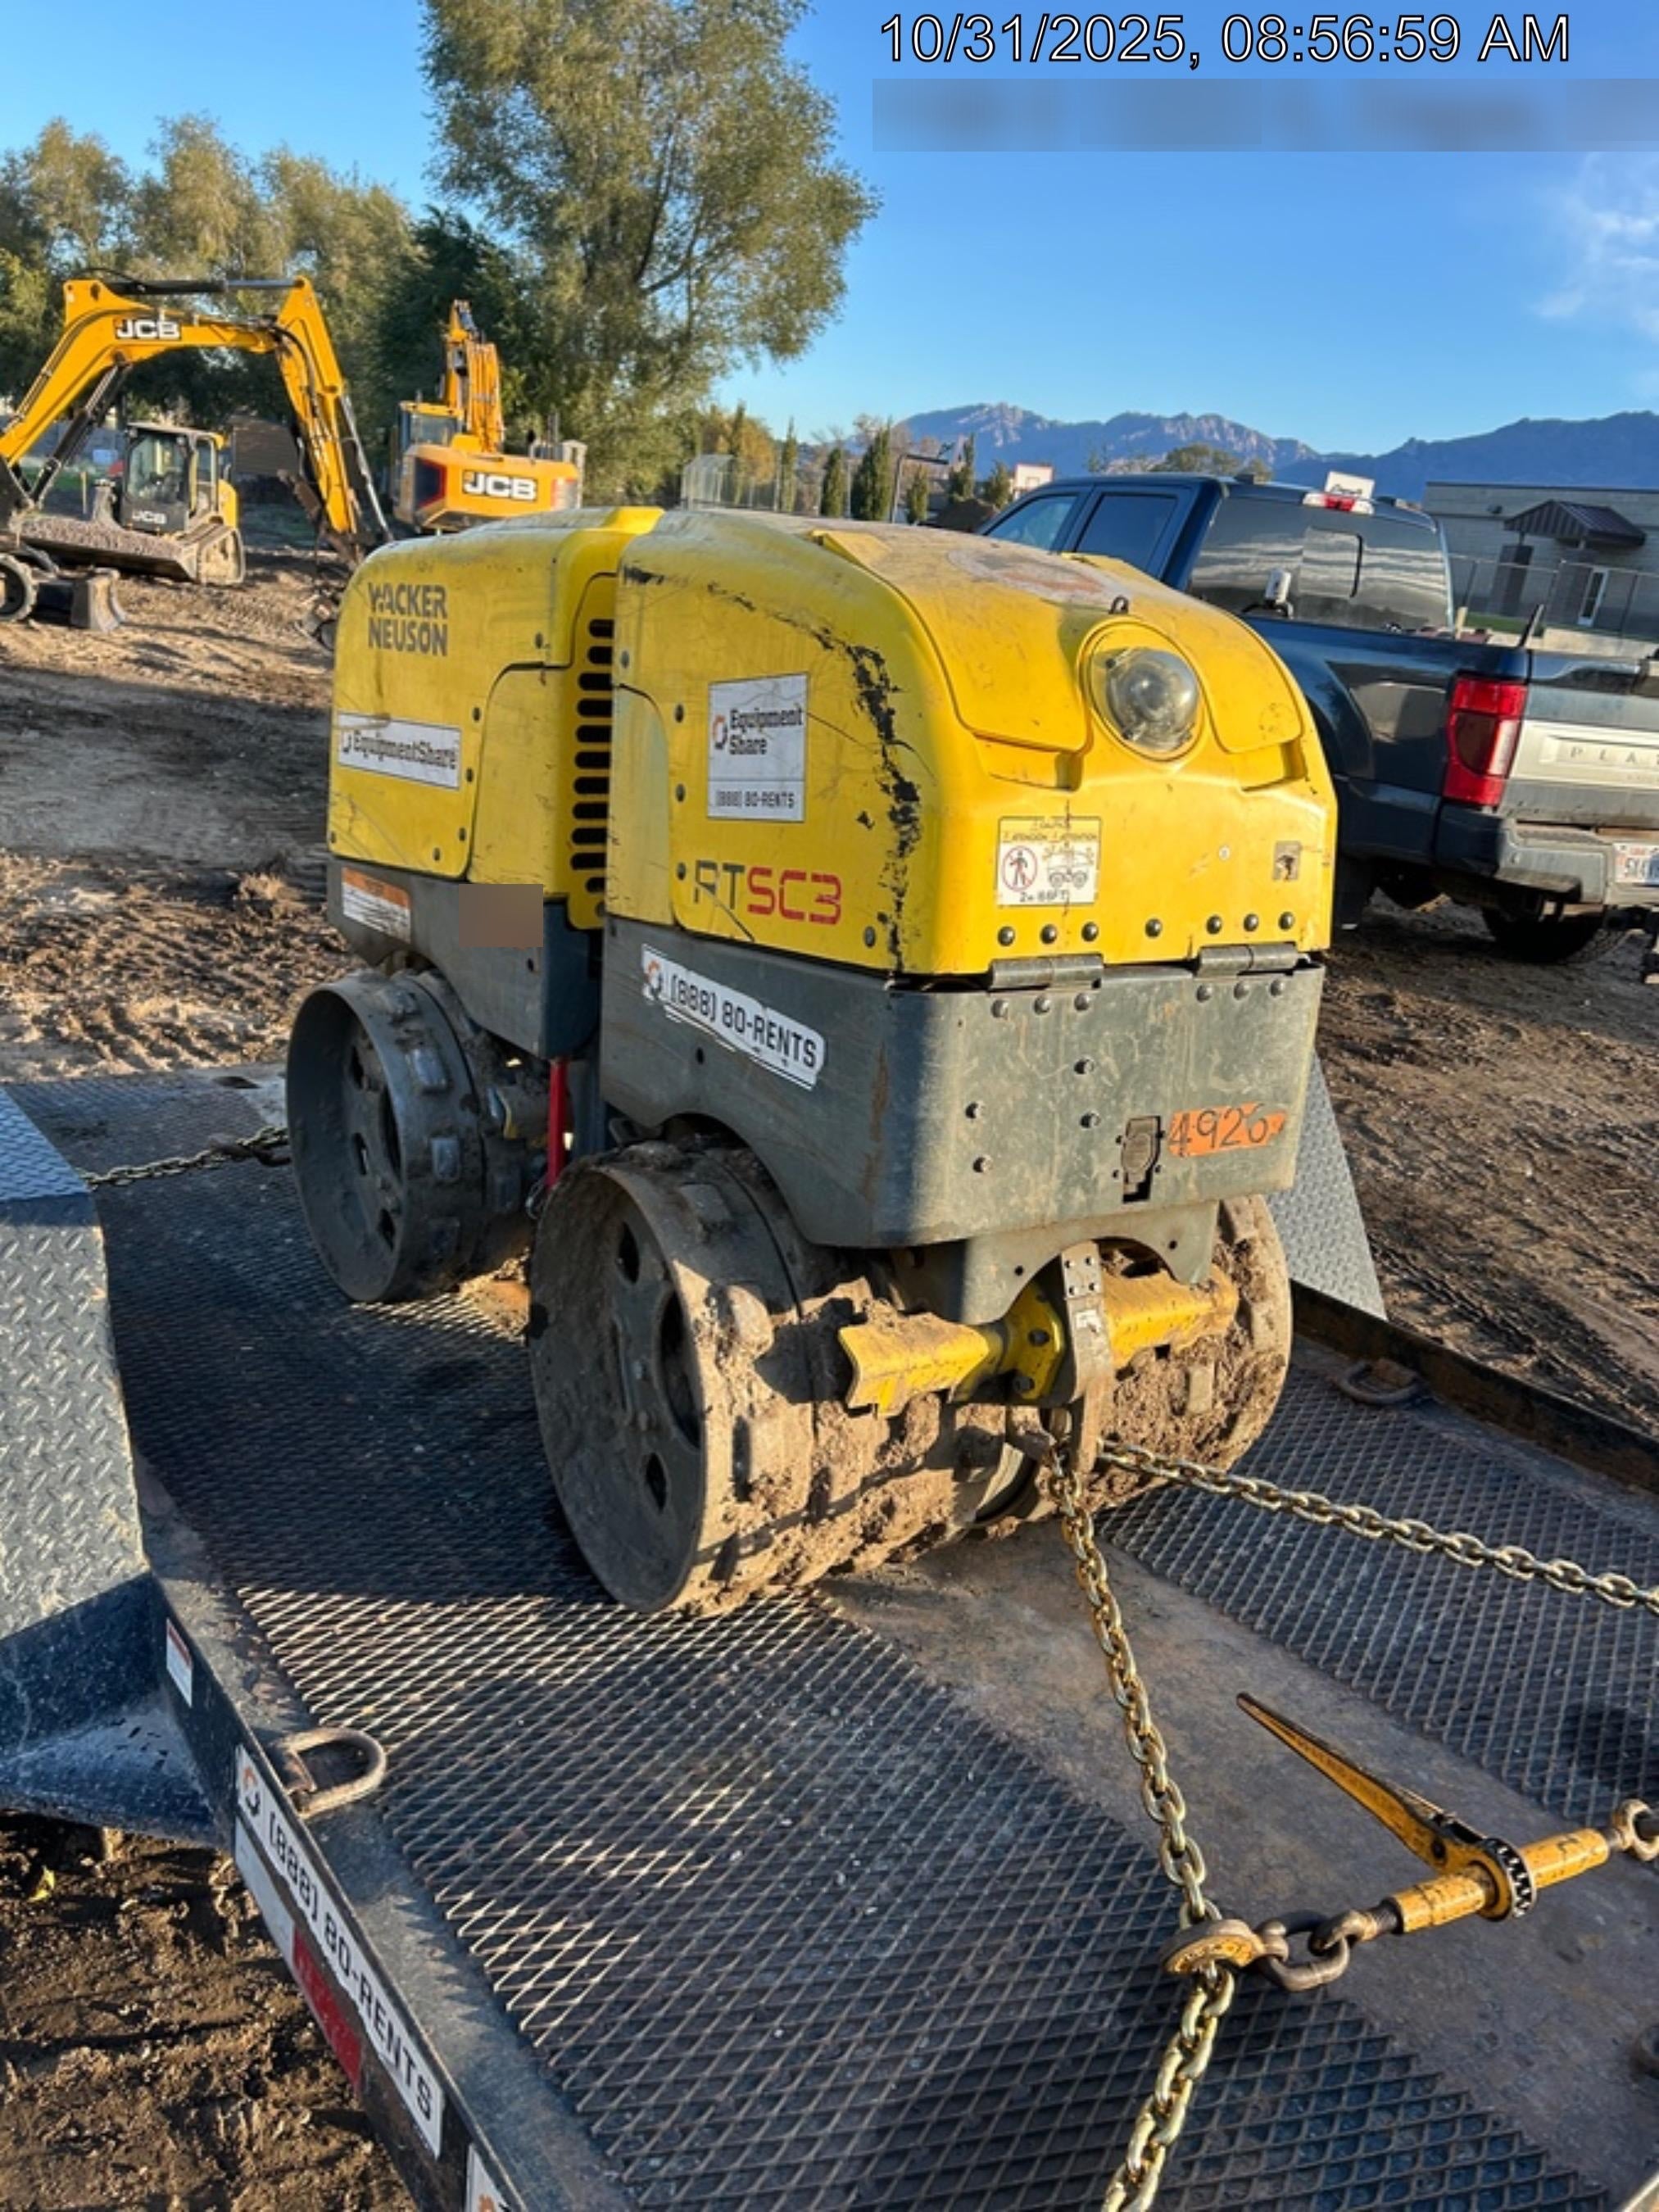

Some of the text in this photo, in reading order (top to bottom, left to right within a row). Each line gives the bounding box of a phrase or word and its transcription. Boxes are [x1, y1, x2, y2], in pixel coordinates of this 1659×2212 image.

[116, 319, 180, 338] JCB
[463, 471, 537, 501] JCB
[368, 582, 447, 619] WACKER
[368, 617, 448, 656] NEUSON
[730, 706, 803, 732] Equipment
[729, 734, 767, 755] Share
[694, 860, 842, 925] RTSC3
[722, 1001, 816, 1067] 80-RENTS
[324, 1911, 432, 2122] 80-RENTS
